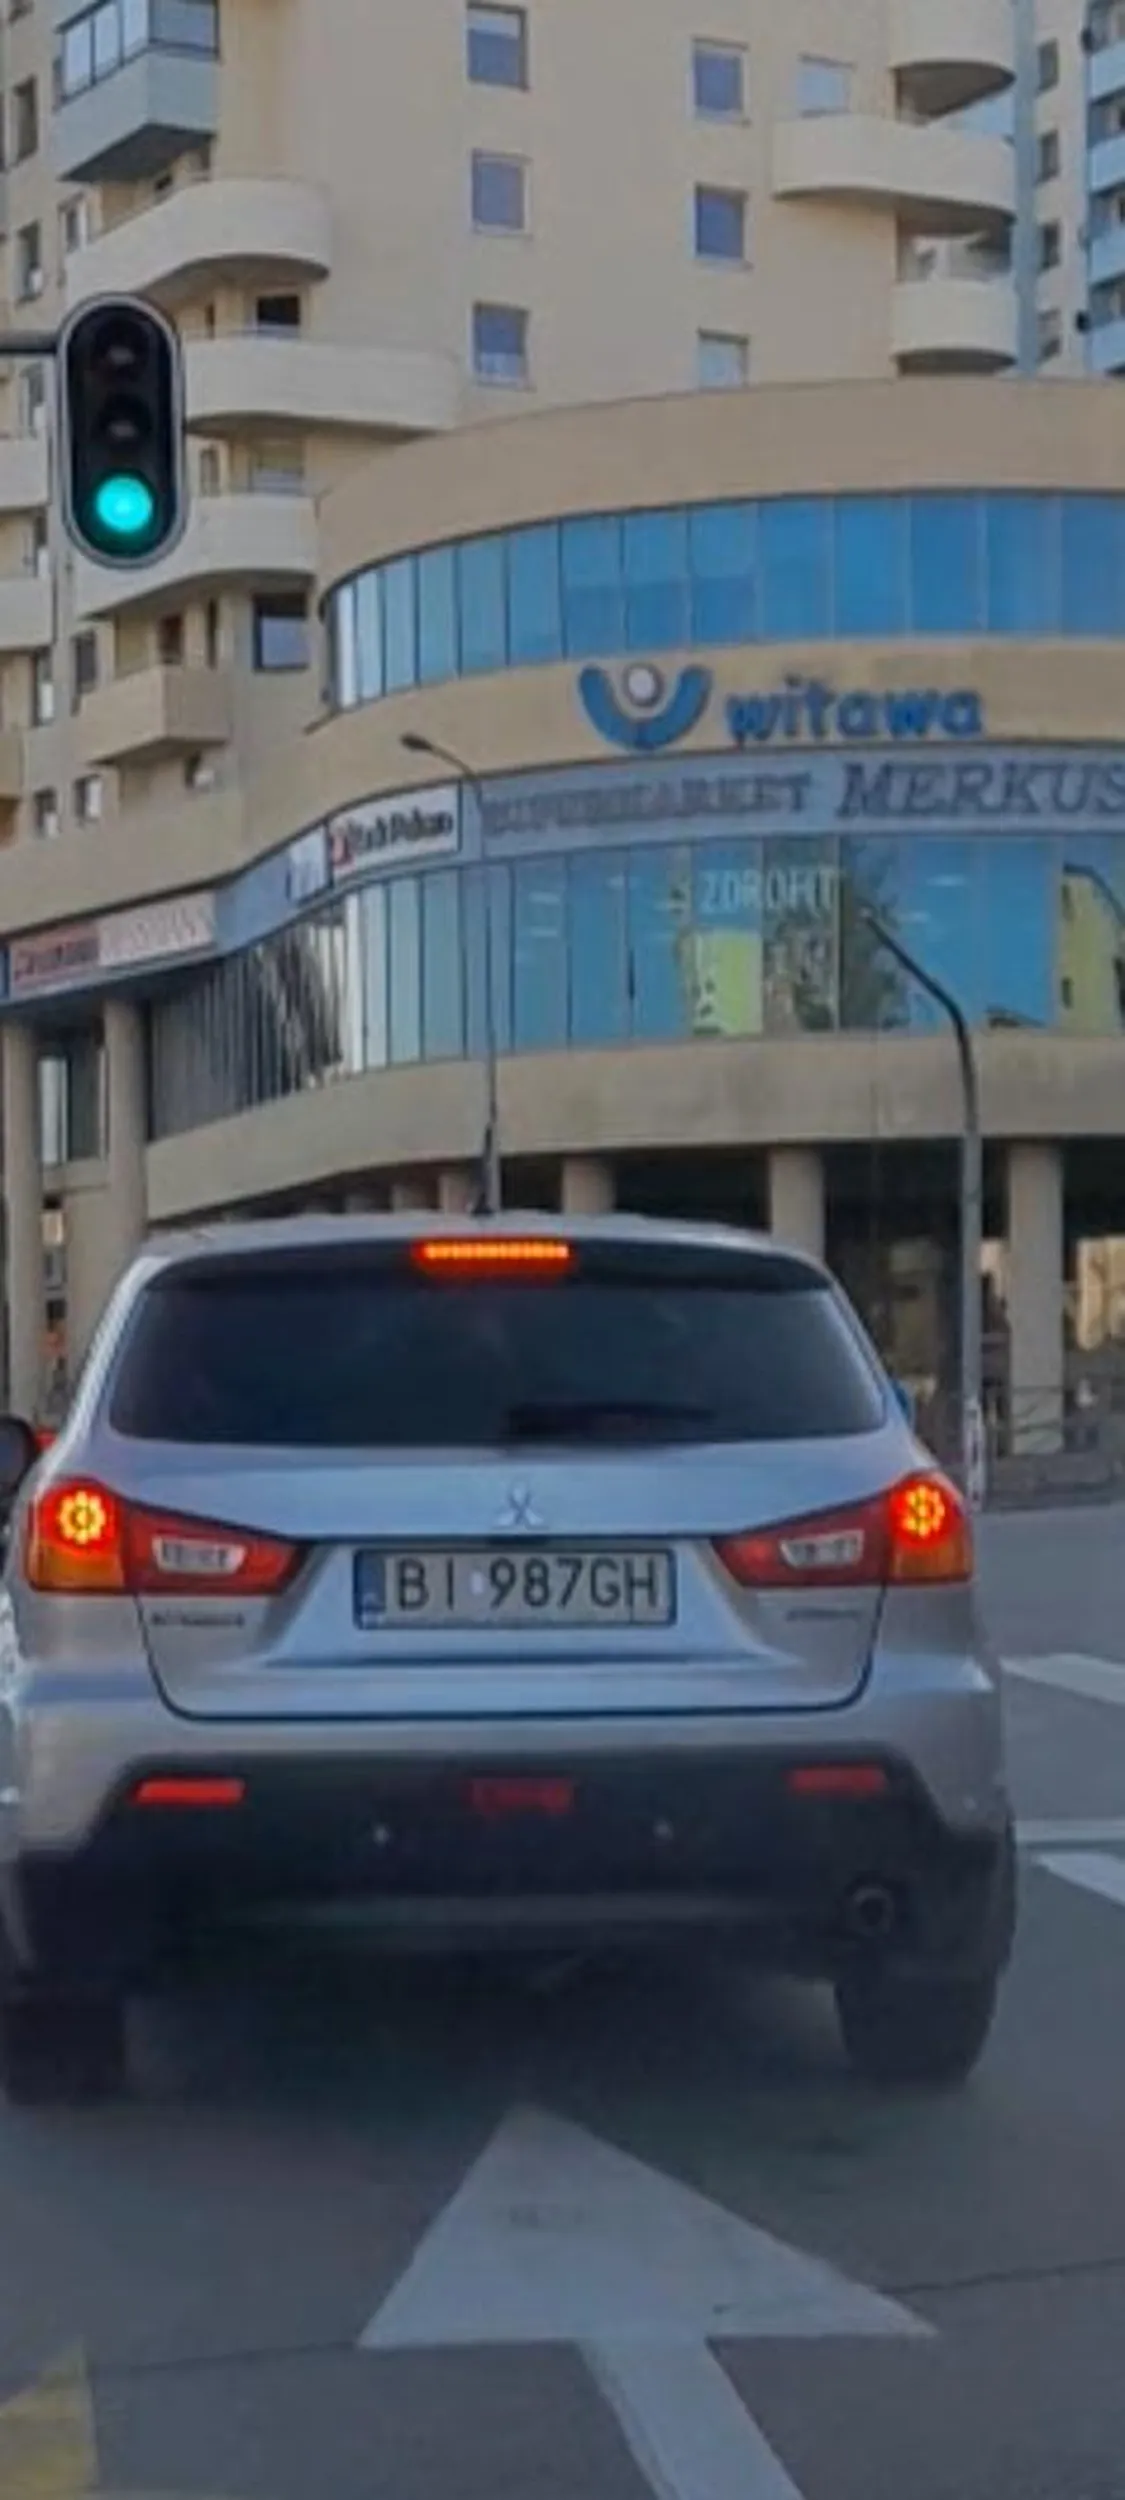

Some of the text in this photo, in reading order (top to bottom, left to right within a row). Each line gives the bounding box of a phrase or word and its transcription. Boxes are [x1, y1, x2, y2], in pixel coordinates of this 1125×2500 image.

[727, 674, 983, 740] witawa
[399, 1557, 660, 1612] BI 987GH
